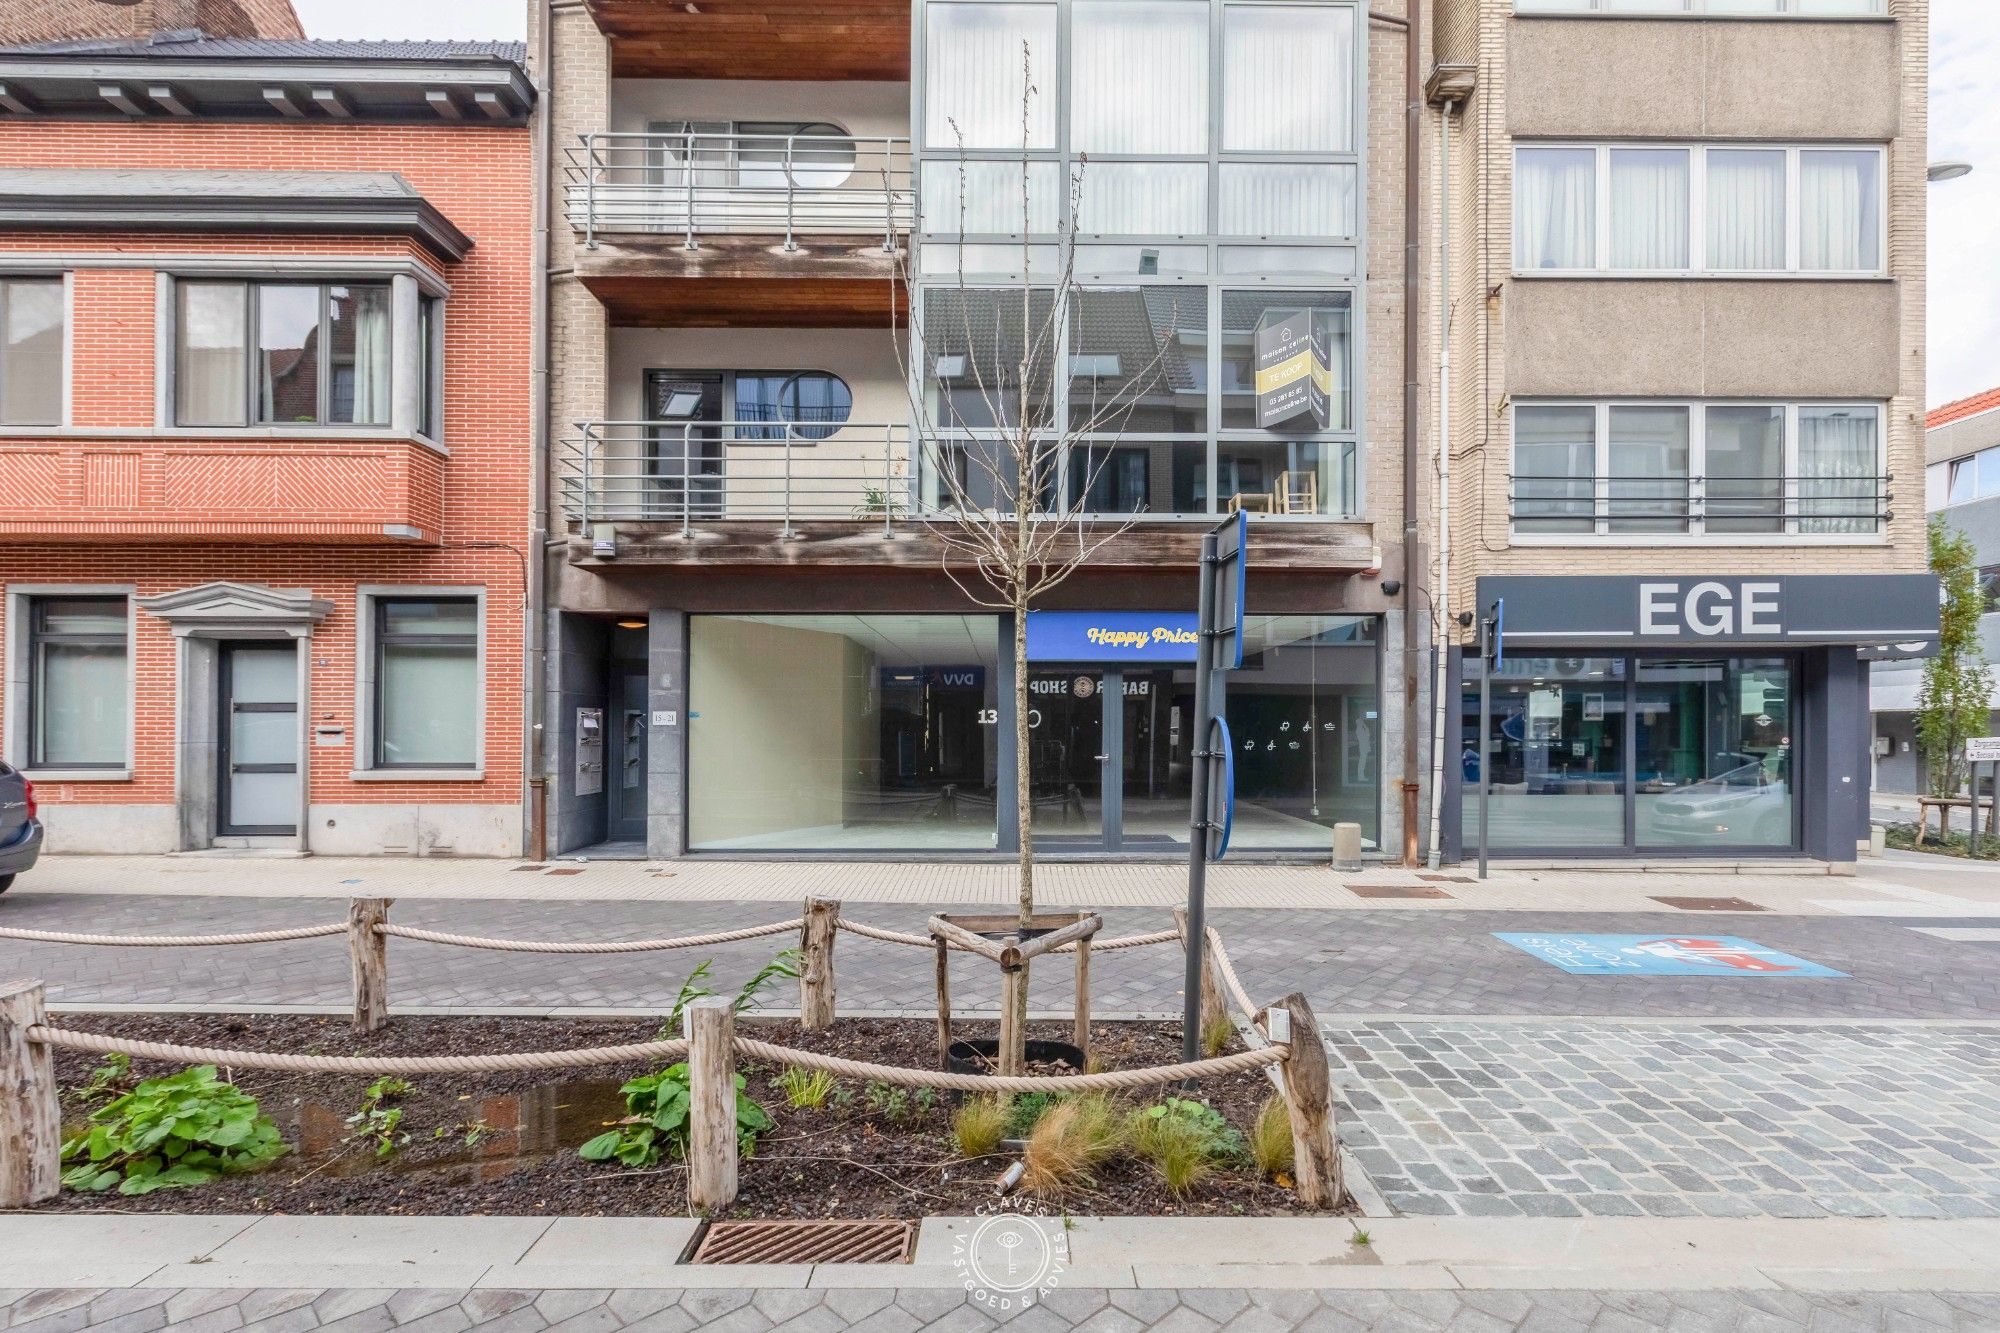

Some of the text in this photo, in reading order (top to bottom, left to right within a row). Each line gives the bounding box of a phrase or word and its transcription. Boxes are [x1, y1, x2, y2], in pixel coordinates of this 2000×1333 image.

[1261, 346, 1287, 361] maison
[1269, 372, 1280, 383] TE
[1281, 361, 1304, 379] KOOP
[1640, 581, 1781, 635] EGE
[1087, 627, 1150, 649] Happy
[977, 709, 998, 724] 13
[1522, 938, 1601, 967] Fiets
